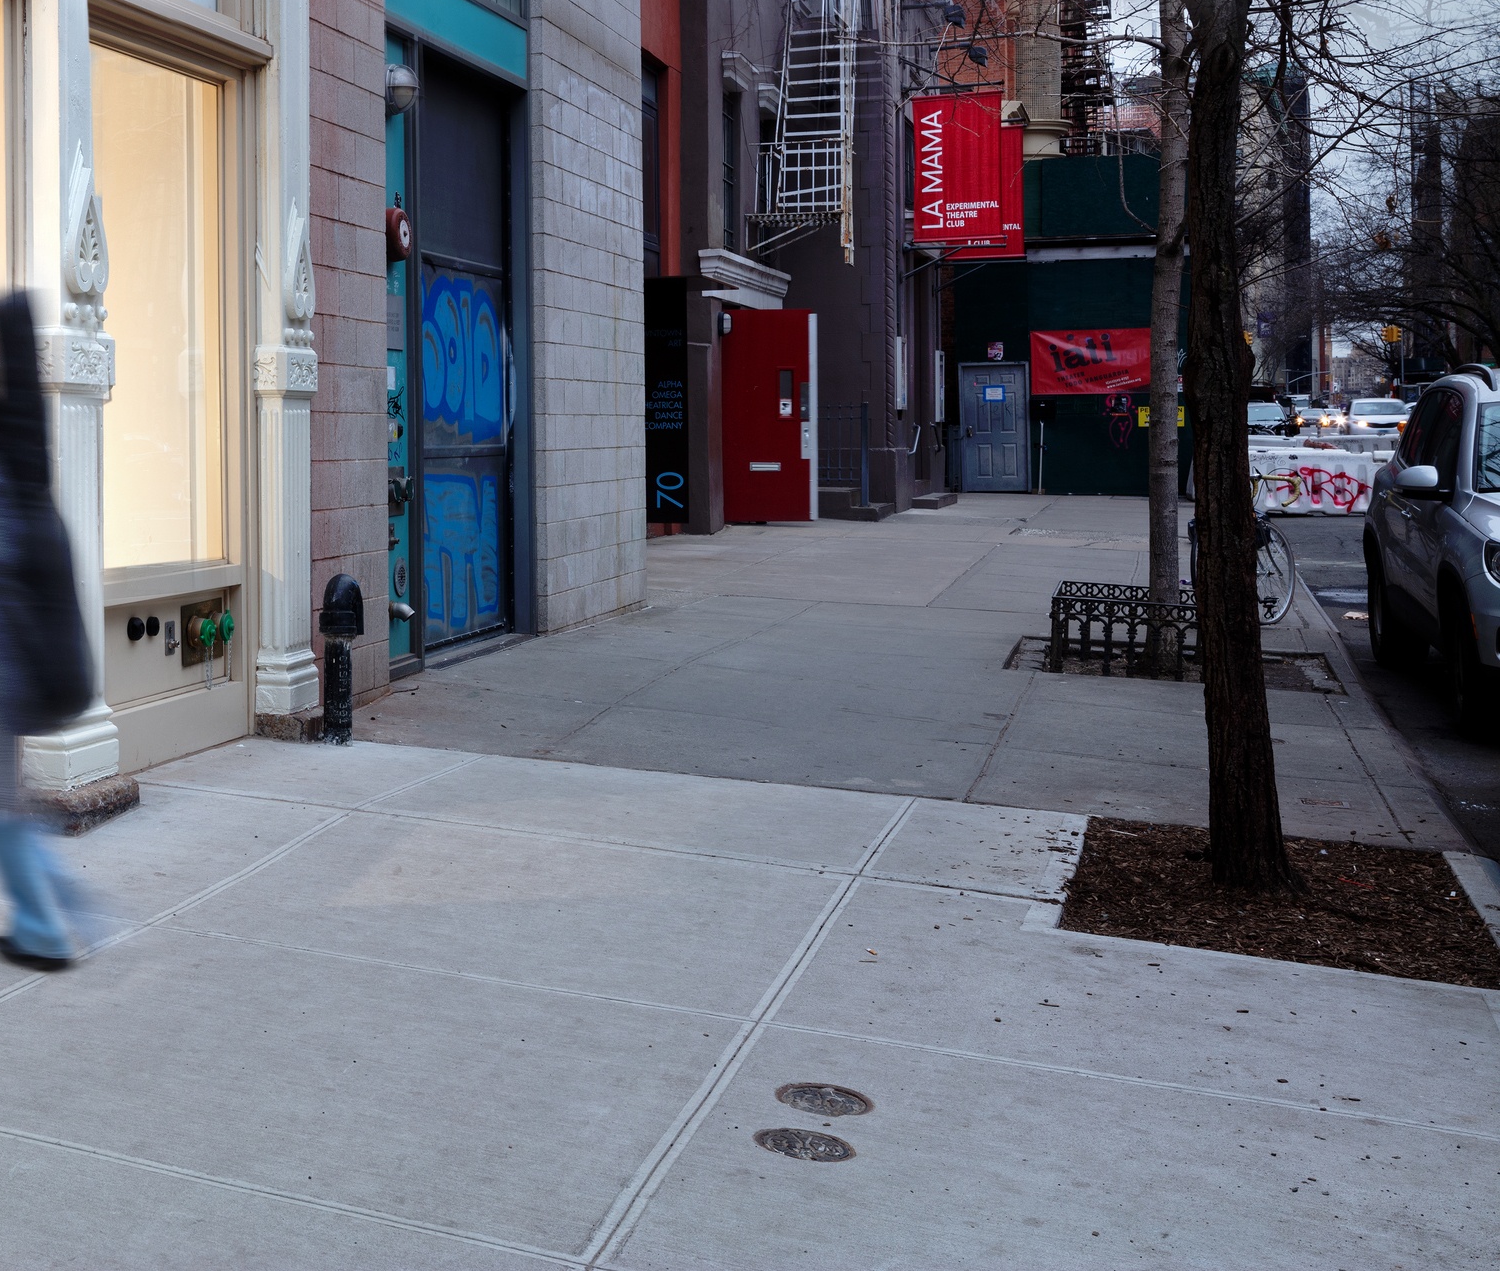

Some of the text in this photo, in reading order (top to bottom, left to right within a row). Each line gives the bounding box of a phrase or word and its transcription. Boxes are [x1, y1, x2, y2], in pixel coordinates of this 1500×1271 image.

[920, 109, 944, 229] LA MAMA
[946, 201, 999, 210] EXPERIMENTAL
[946, 210, 978, 219] THEATRE
[946, 220, 965, 228] CLUB
[1057, 371, 1085, 382] THEATER
[1085, 369, 1129, 384] VANGUARDIA
[658, 380, 683, 388] ALPHA
[651, 391, 683, 399] OMEGA
[655, 411, 683, 419] DANCE
[656, 471, 684, 509] 70
